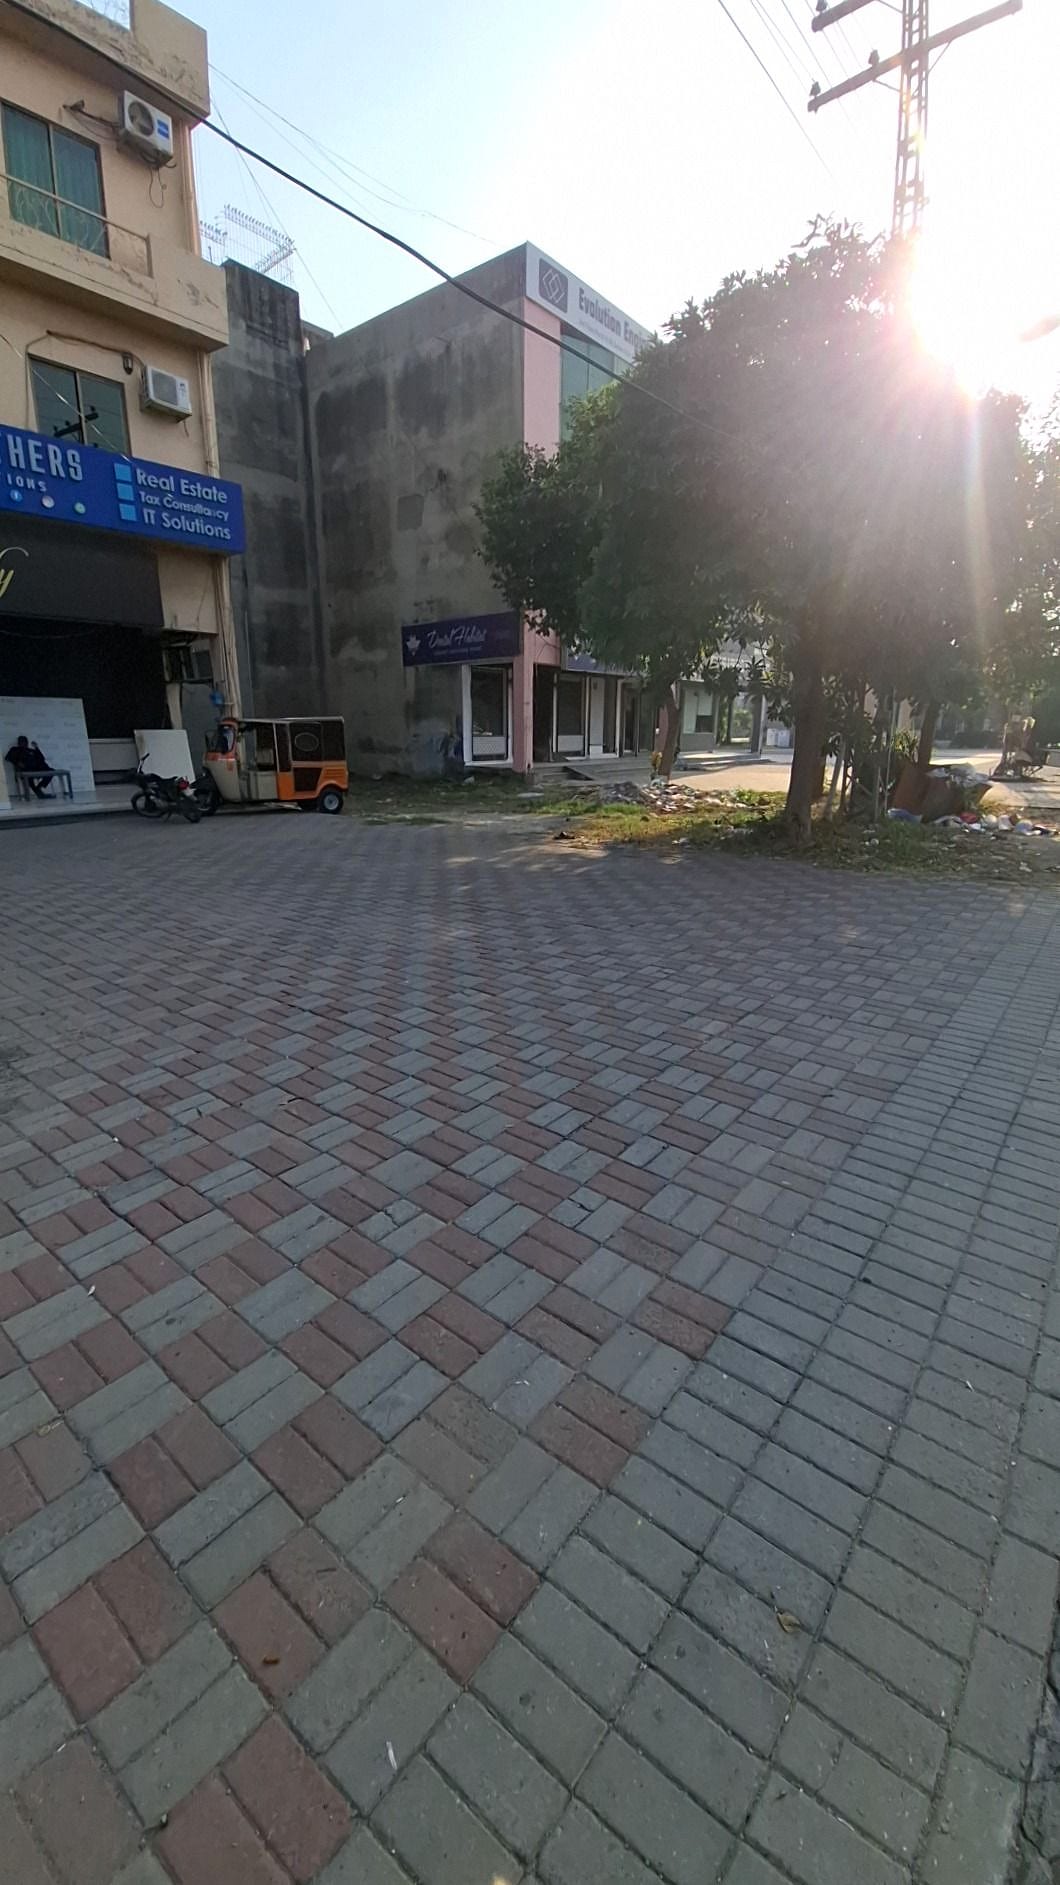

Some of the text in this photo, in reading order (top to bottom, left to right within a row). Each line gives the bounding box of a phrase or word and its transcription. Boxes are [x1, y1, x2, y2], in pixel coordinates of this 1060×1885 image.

[0, 433, 83, 481] HERS
[136, 468, 228, 503] Real Estate
[139, 491, 161, 506] Tax
[143, 508, 231, 540] IT Solutions
